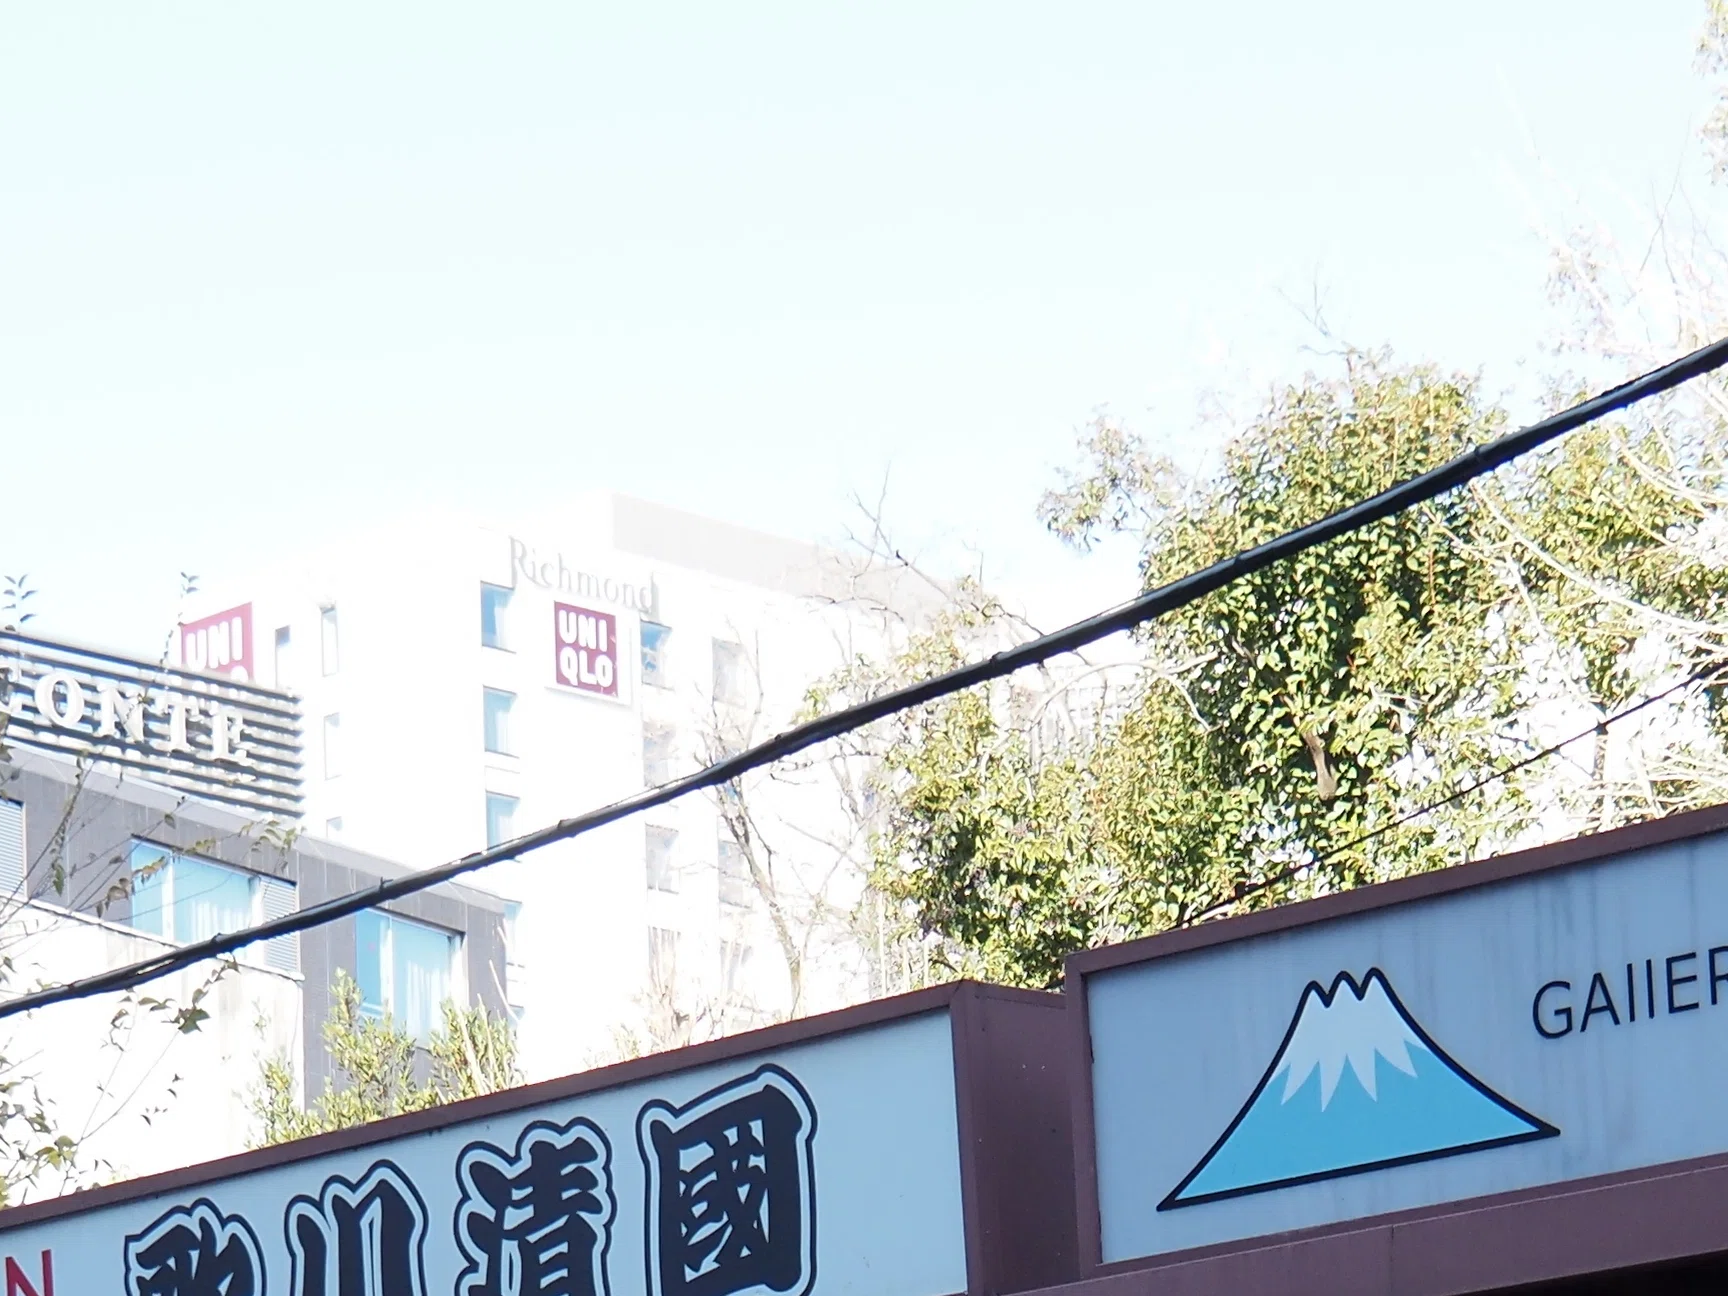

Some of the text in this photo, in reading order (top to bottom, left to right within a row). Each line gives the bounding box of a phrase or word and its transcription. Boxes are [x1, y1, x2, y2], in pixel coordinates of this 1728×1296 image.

[508, 535, 660, 620] Richmond
[185, 616, 244, 672] UNI
[558, 608, 608, 652] UNI
[559, 645, 614, 688] QLO
